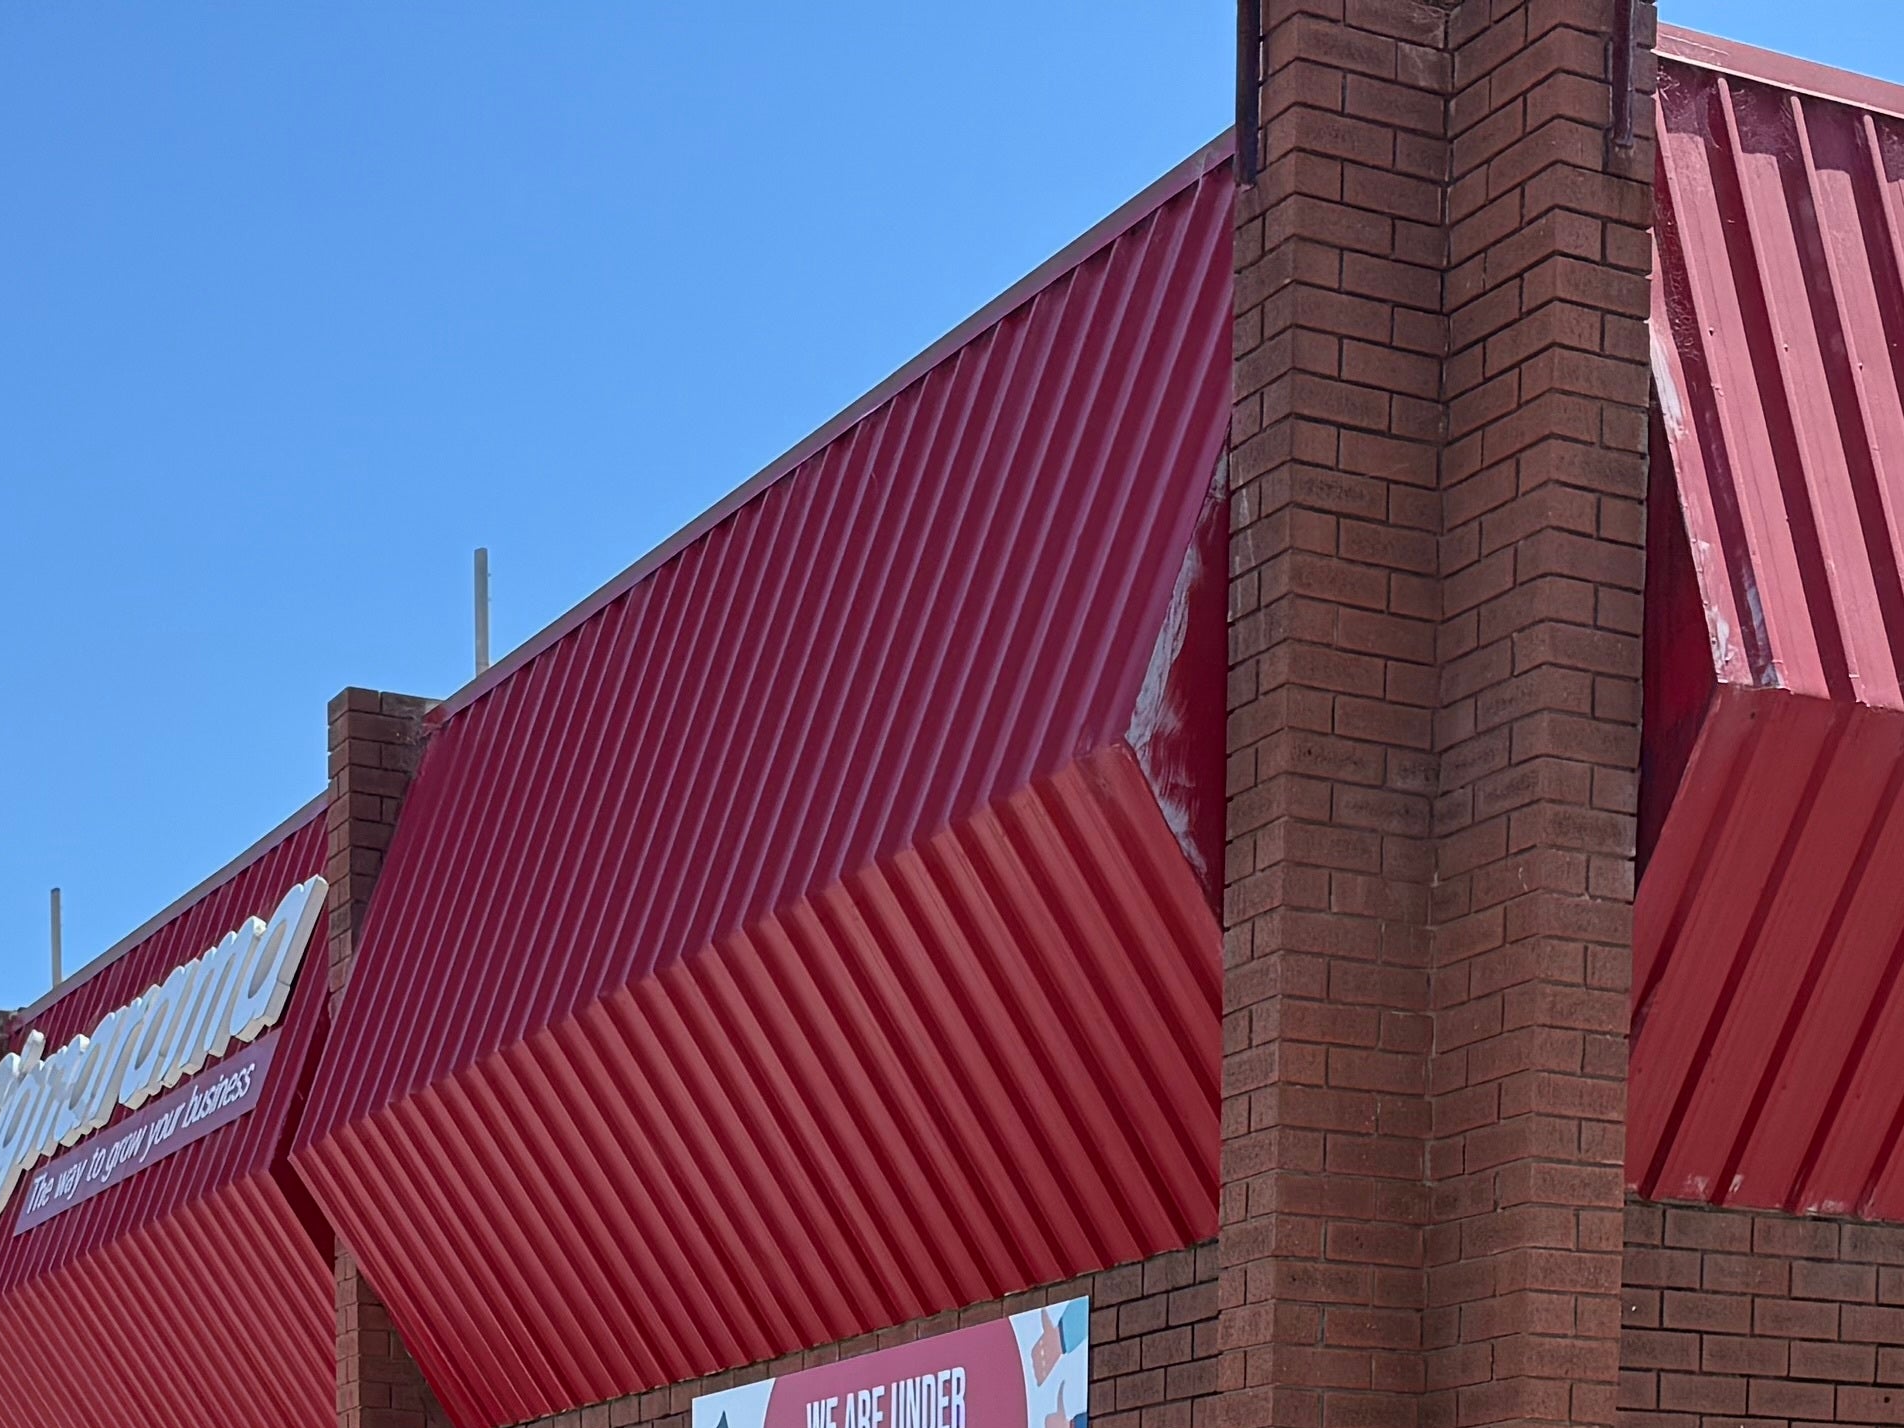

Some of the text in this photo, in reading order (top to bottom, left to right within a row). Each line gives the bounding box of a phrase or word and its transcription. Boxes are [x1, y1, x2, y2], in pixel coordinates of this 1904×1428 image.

[26, 1059, 256, 1217] The way to grow your business
